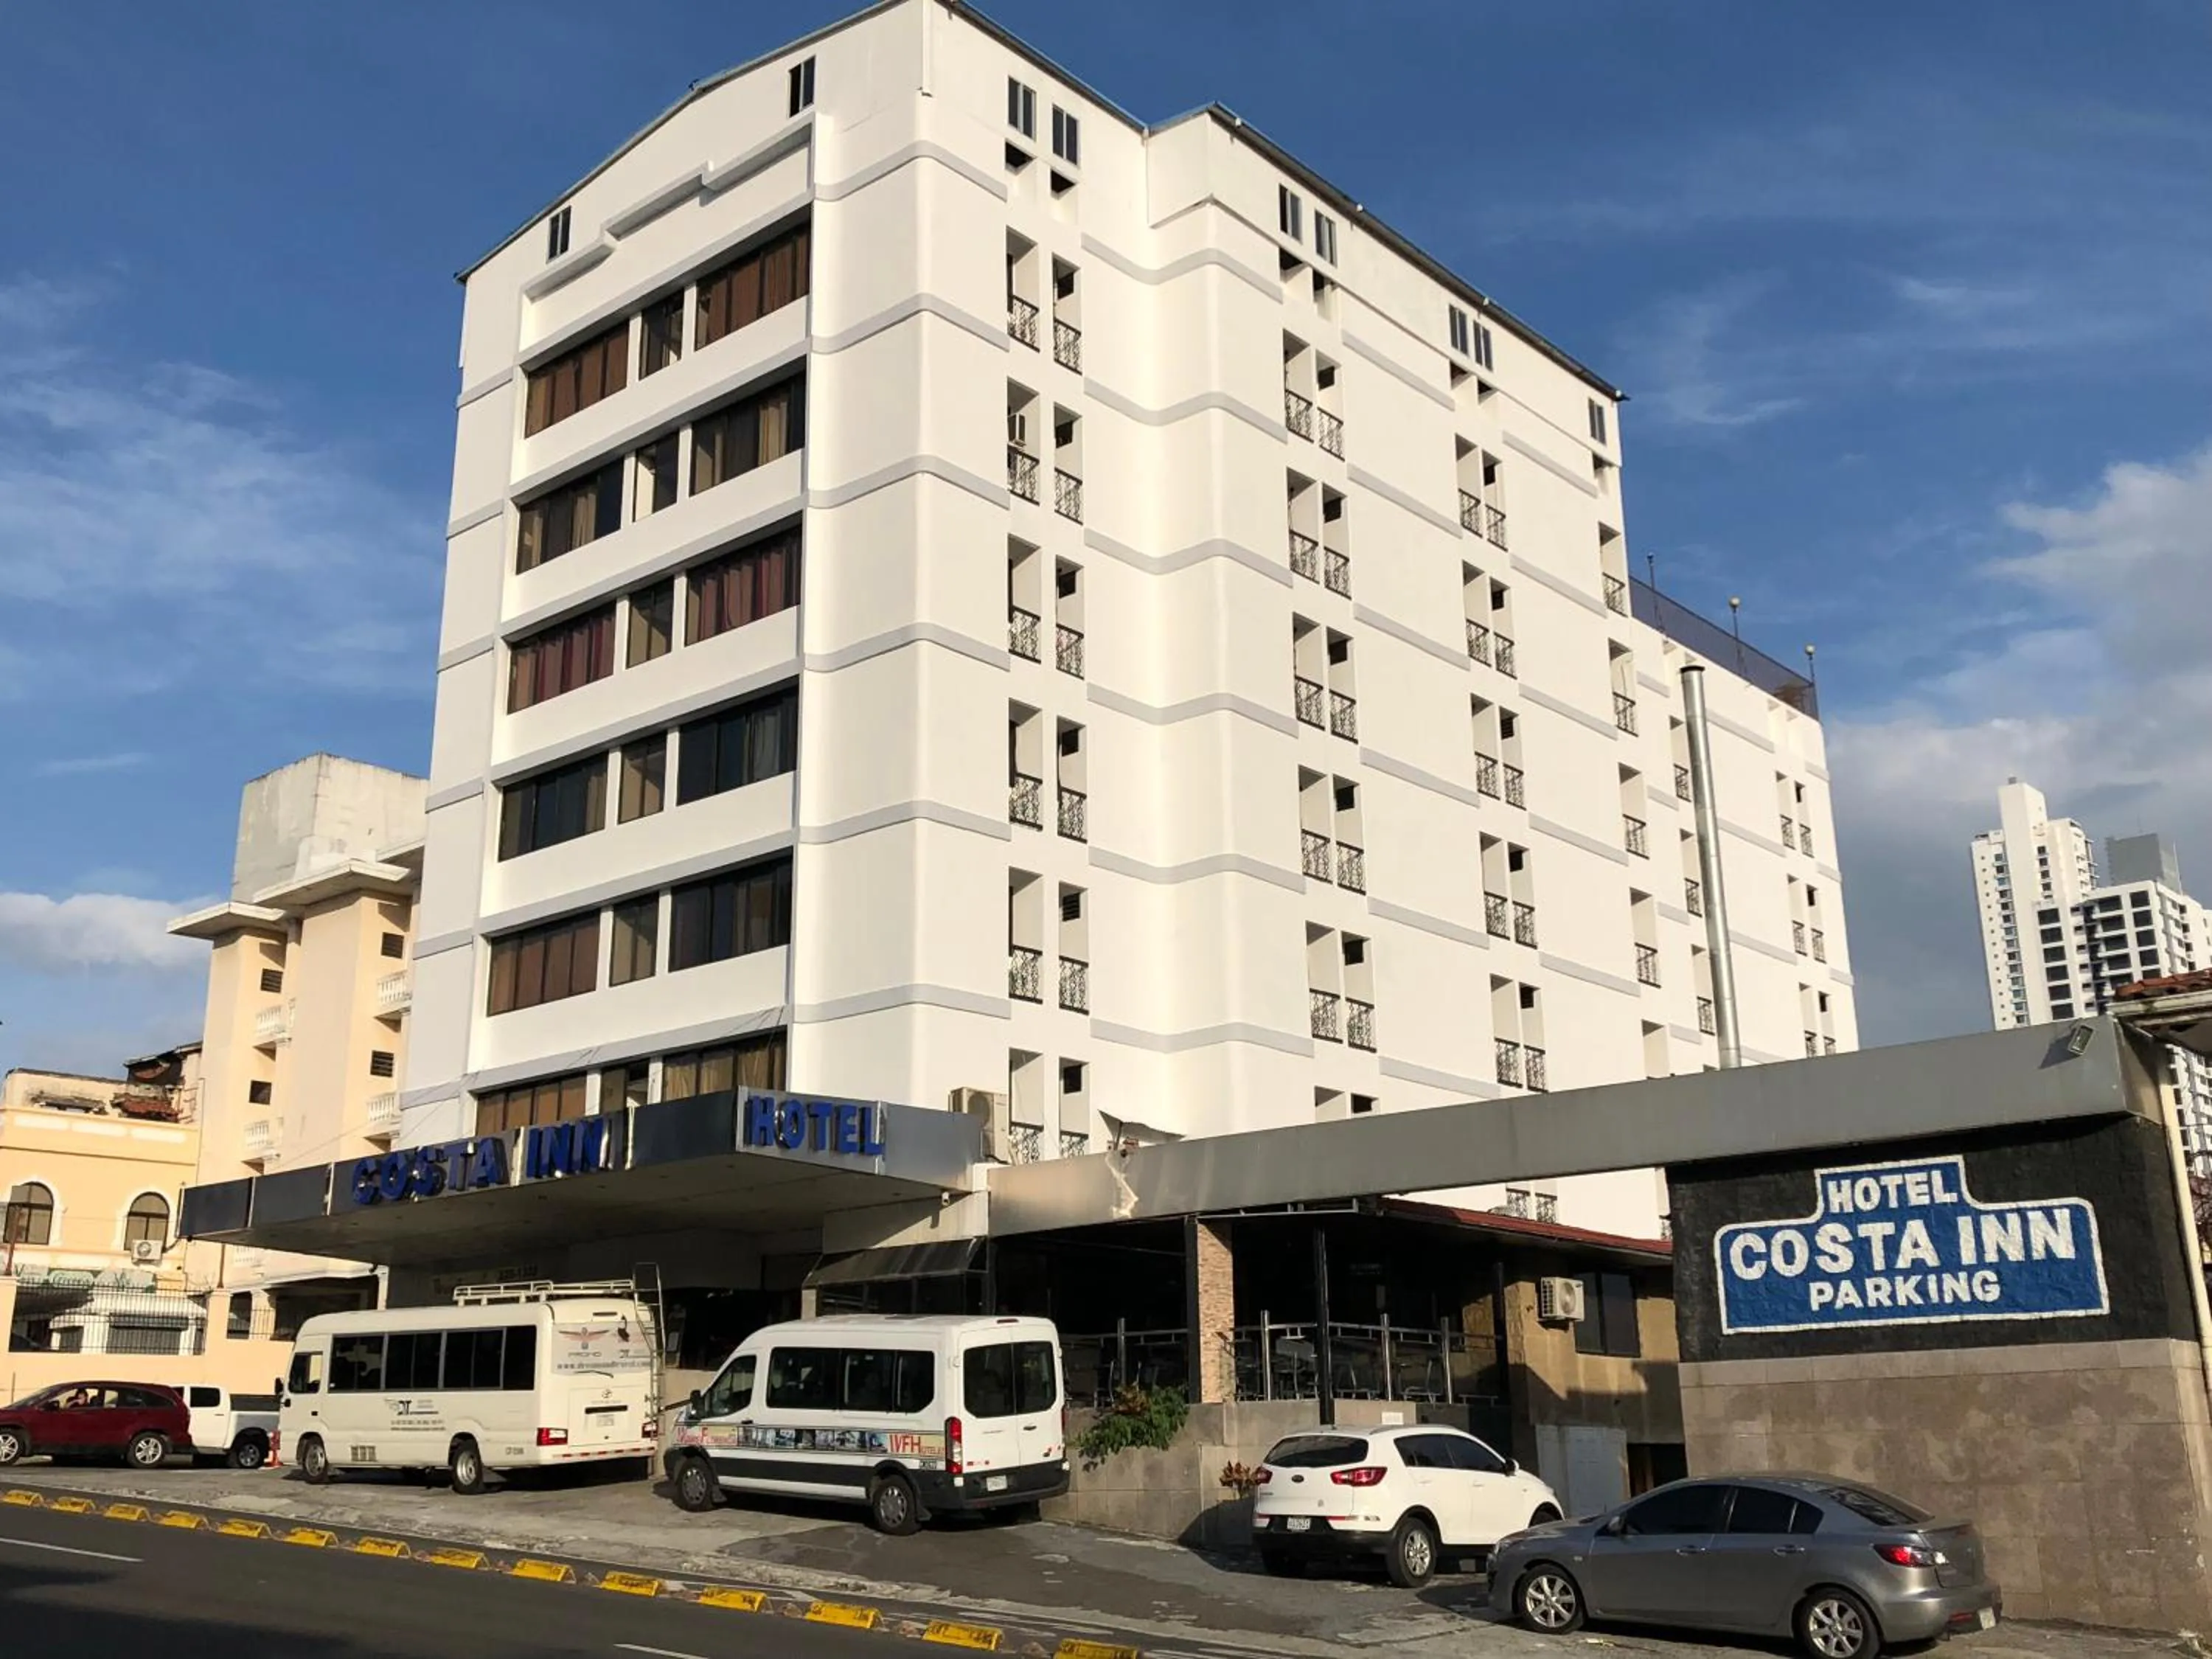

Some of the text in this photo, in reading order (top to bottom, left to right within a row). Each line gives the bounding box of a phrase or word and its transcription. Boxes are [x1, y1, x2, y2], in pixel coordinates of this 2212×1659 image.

[744, 1095, 886, 1156] HOTEL
[352, 1118, 608, 1206] COSTA INN
[1827, 1170, 1959, 1214] HOTEL
[1728, 1208, 2076, 1281] COSTA INN
[1809, 1270, 2001, 1311] PARKING
